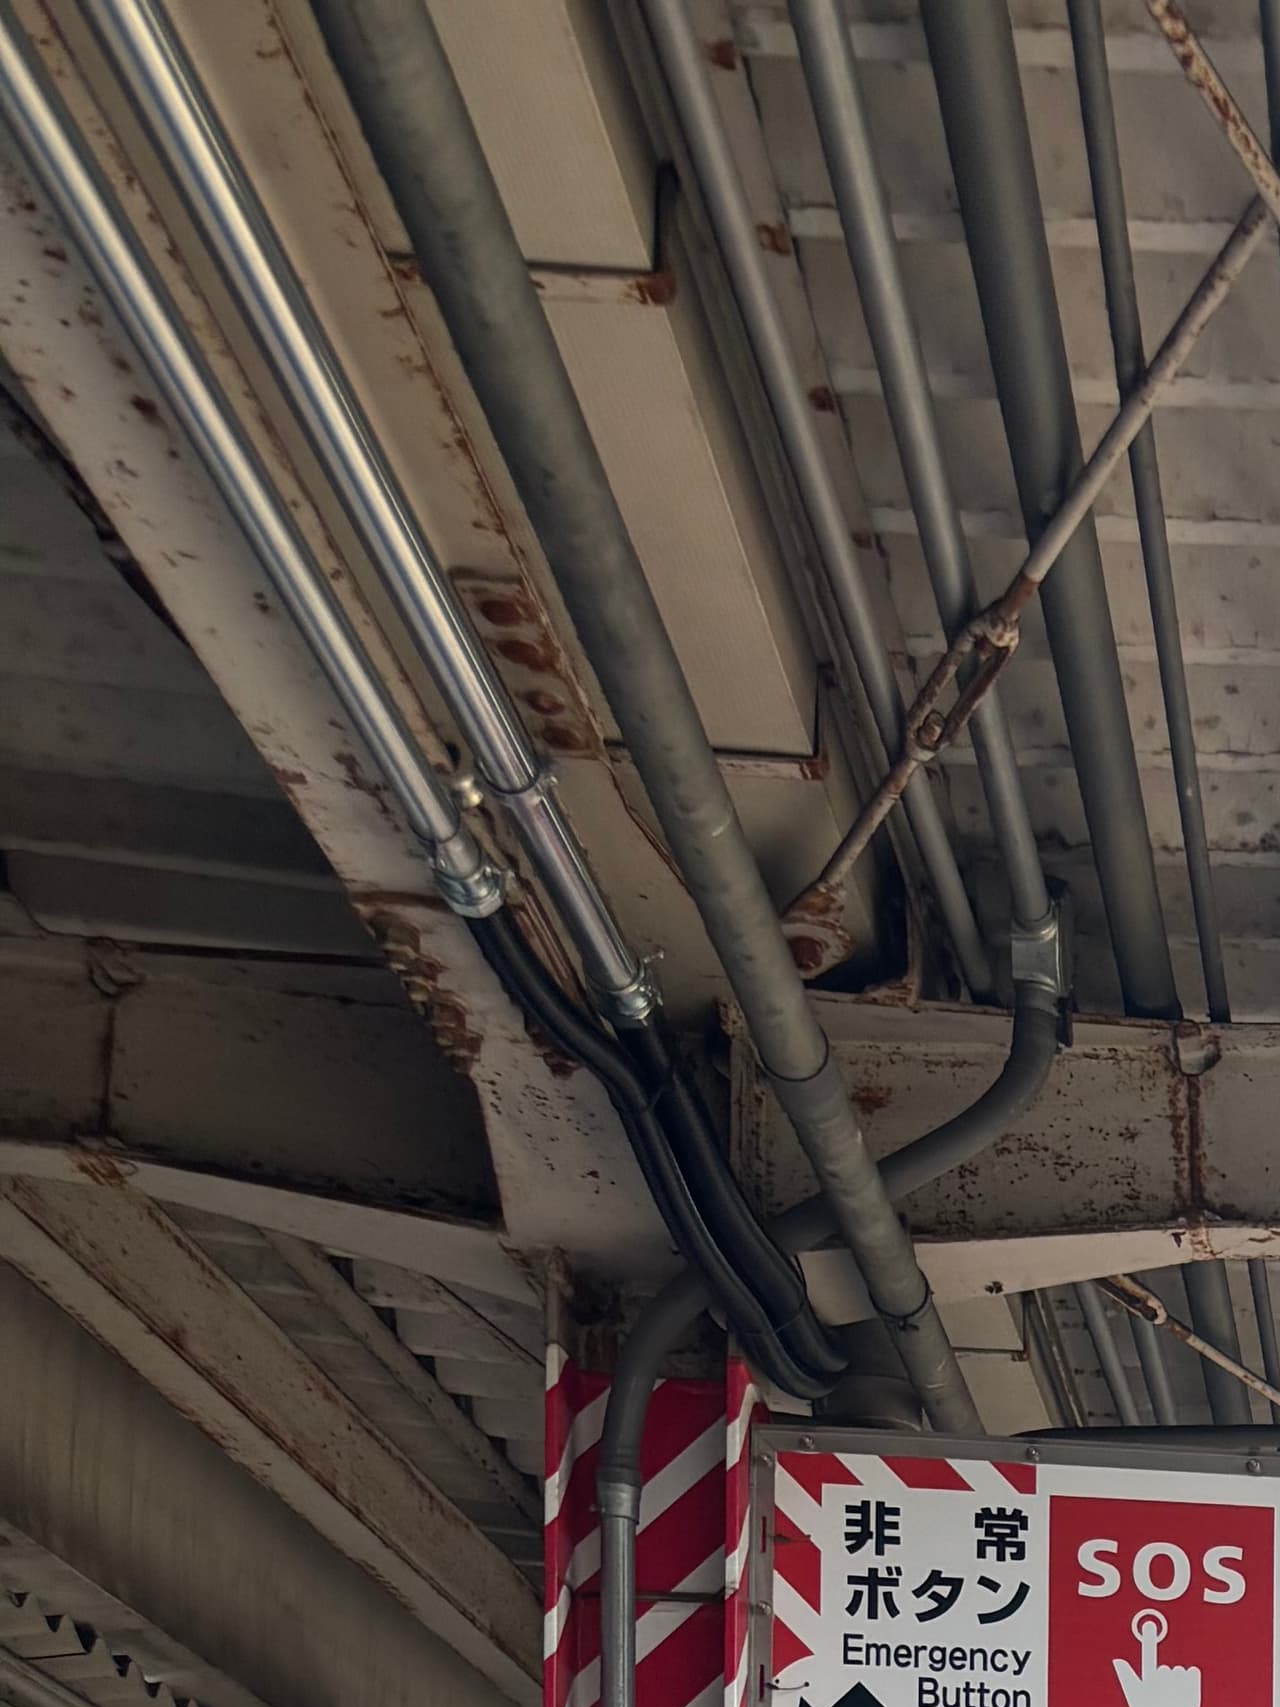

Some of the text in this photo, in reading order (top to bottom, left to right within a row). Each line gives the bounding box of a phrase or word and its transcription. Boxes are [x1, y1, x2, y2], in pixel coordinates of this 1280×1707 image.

[844, 1500, 1030, 1562] 非常
[845, 1567, 1031, 1625] ボタン
[1076, 1538, 1247, 1604] SOS
[843, 1632, 1032, 1675] Emergency
